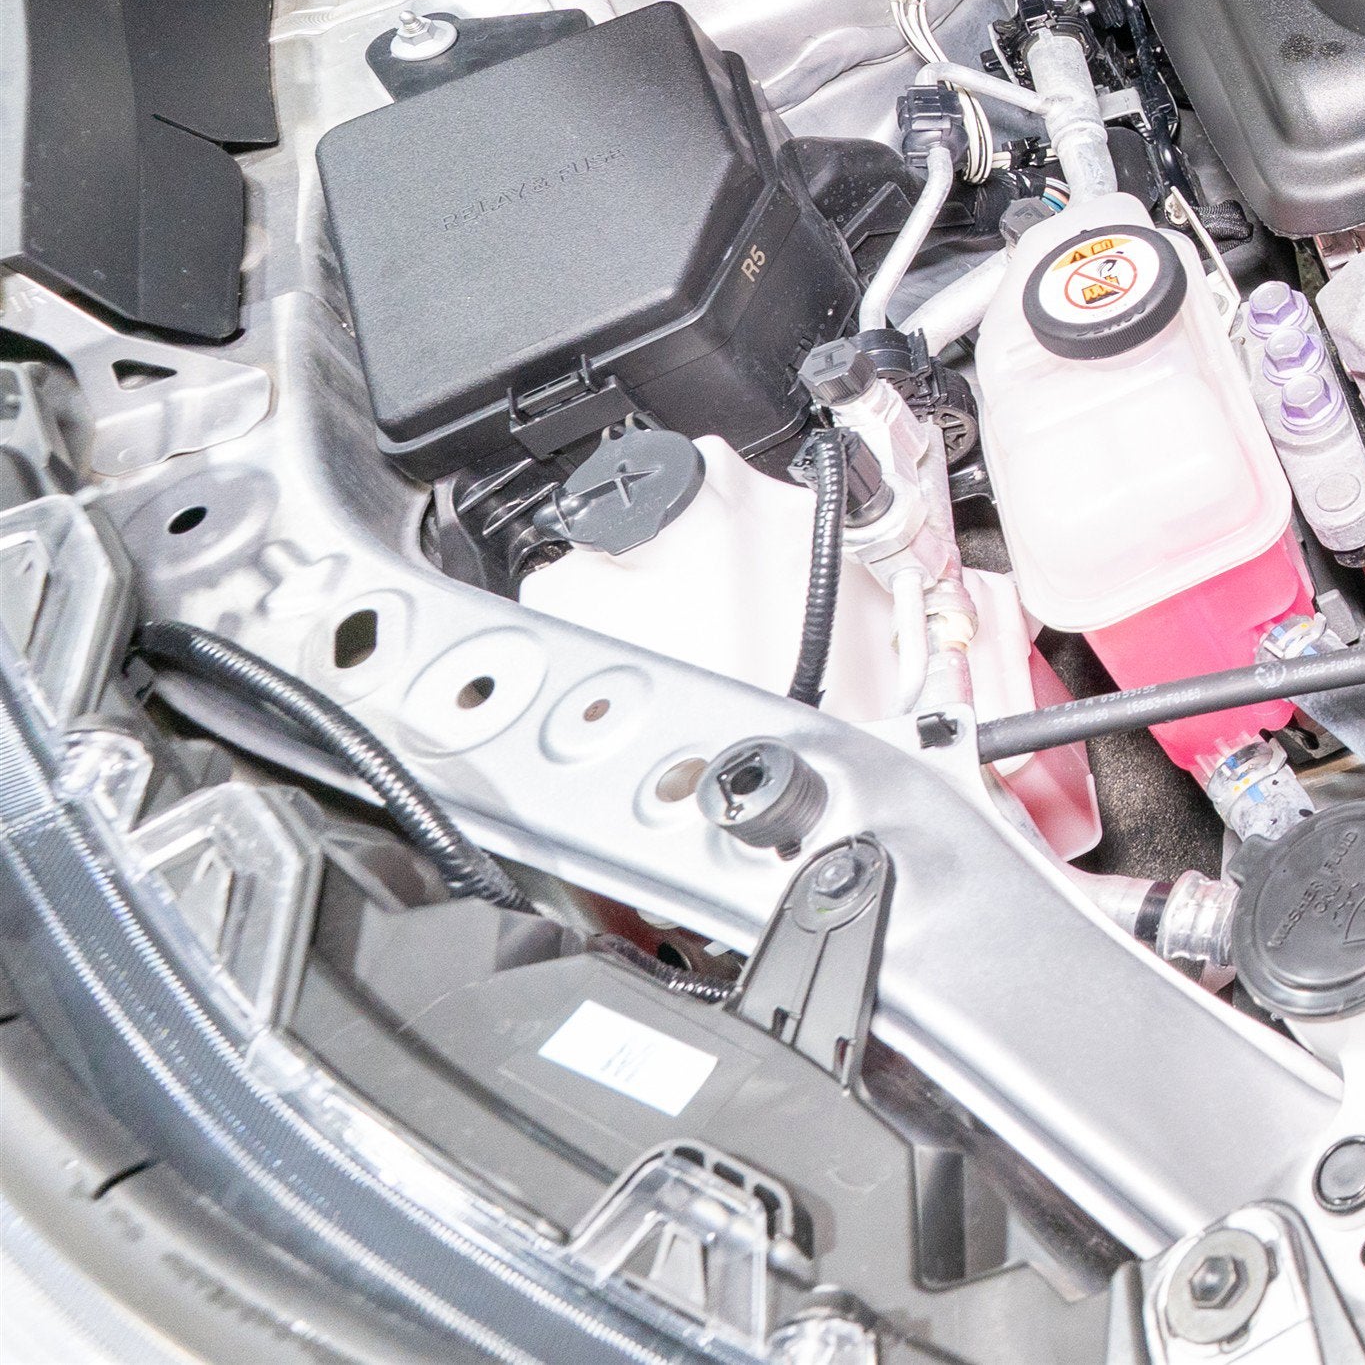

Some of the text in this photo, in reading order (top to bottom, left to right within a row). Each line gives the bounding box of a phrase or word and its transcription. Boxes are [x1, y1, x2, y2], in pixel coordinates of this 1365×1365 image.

[441, 146, 624, 232] RELAY & FUSE
[740, 245, 768, 283] R5
[1266, 830, 1359, 949] WASHER FLUID
[1312, 874, 1344, 915] ONLY
